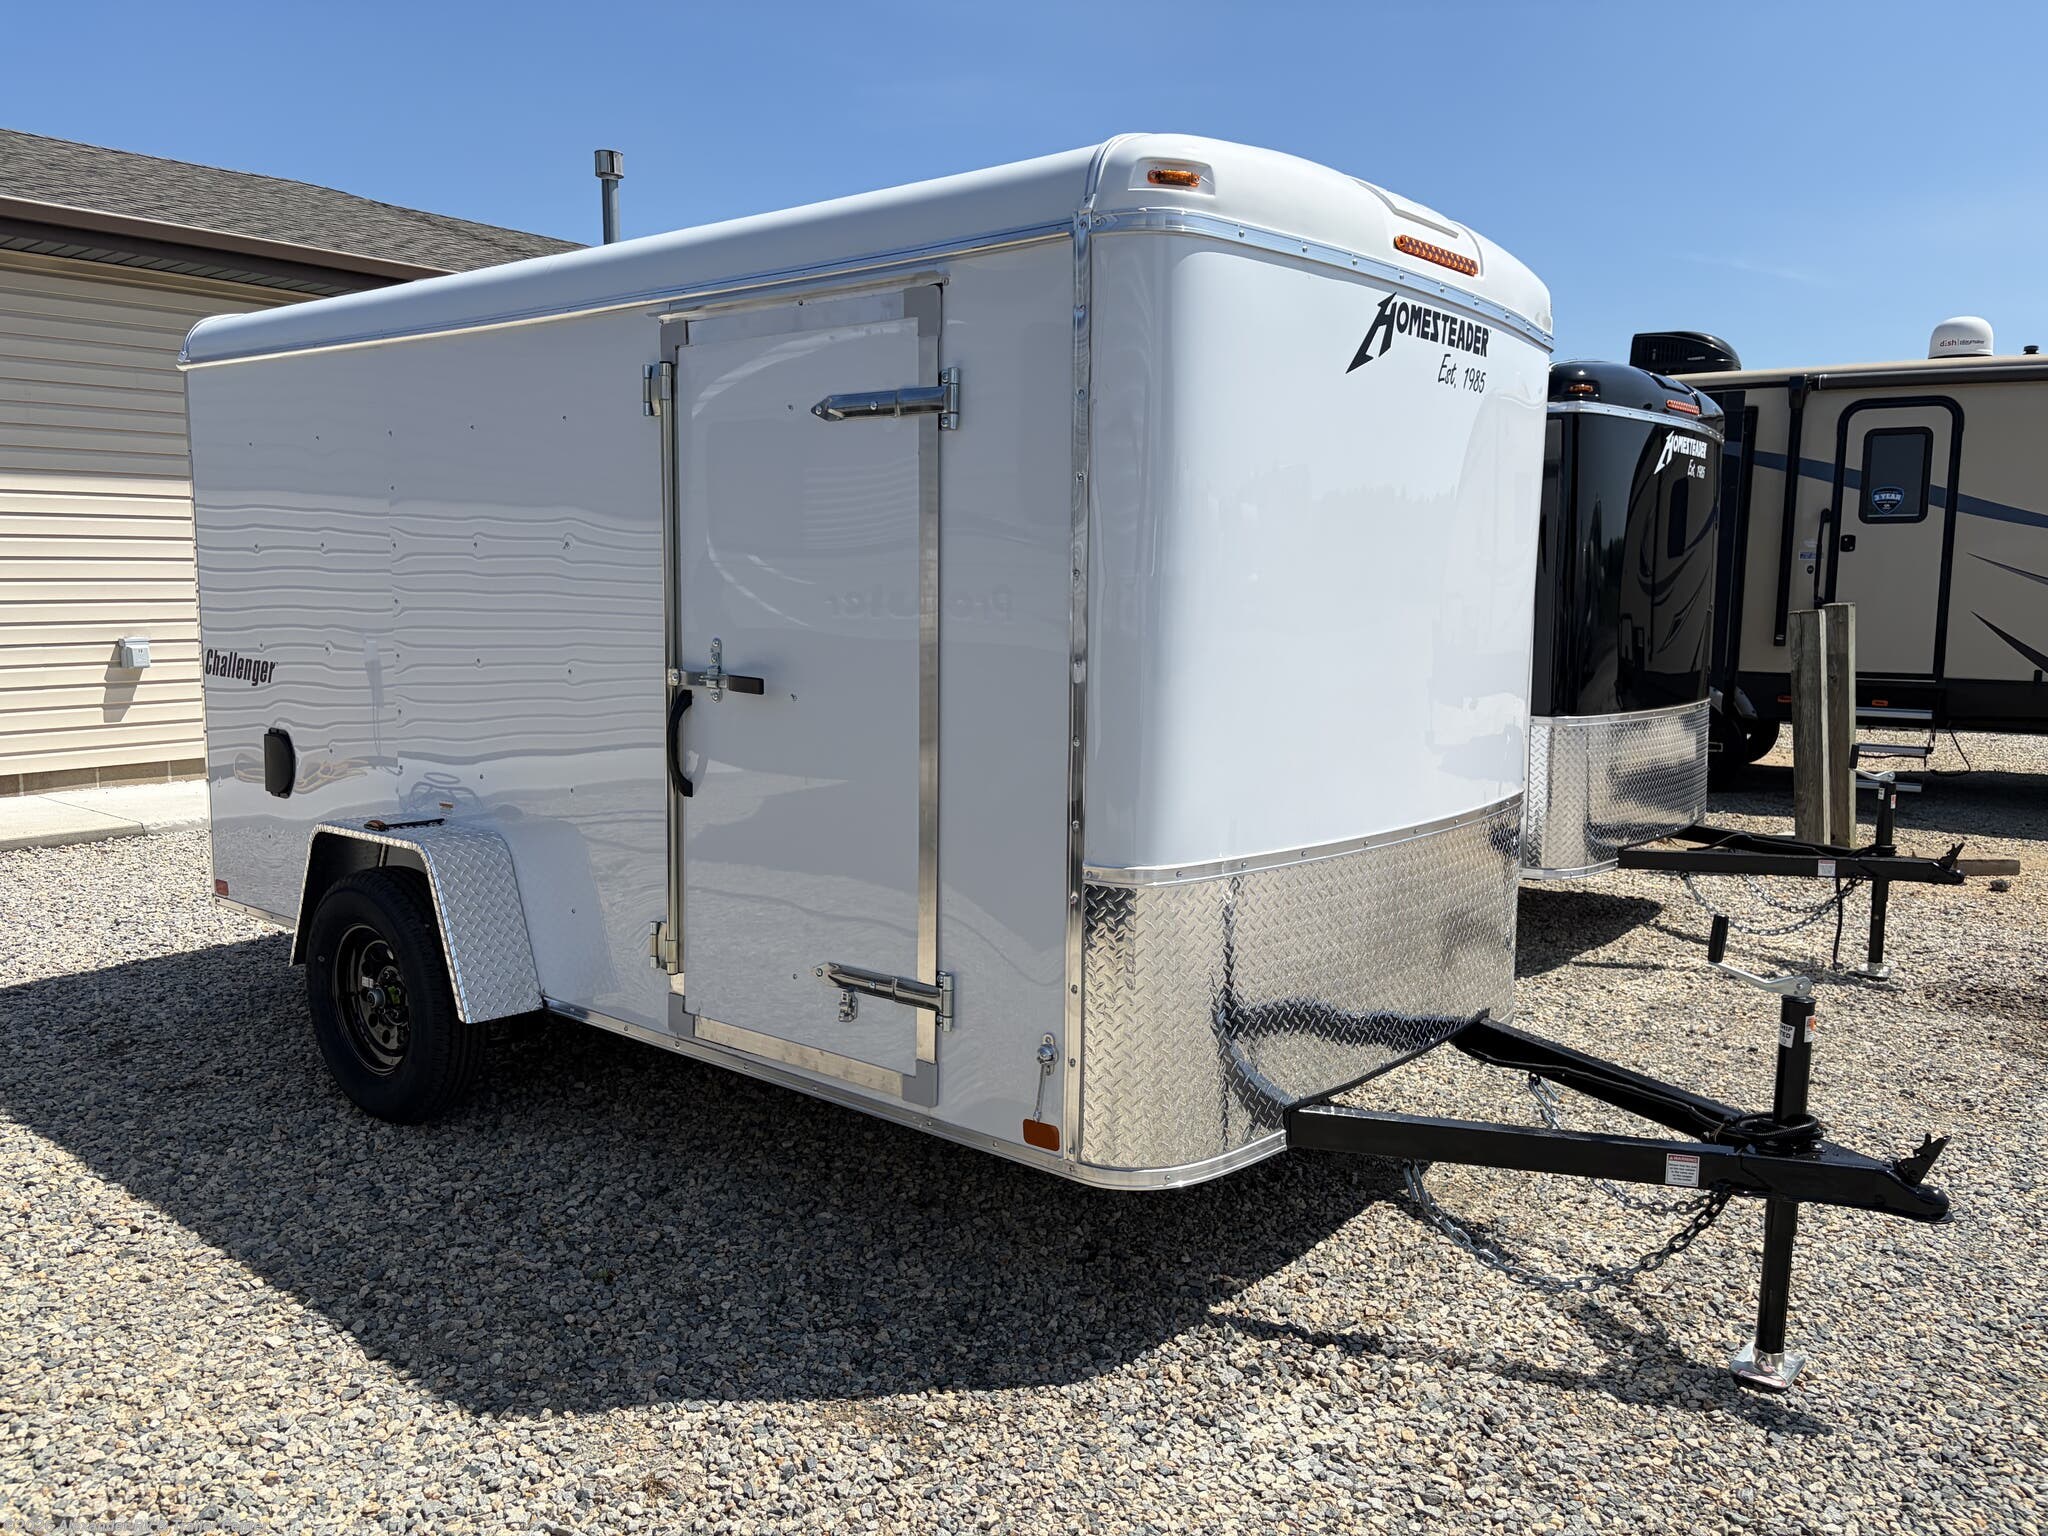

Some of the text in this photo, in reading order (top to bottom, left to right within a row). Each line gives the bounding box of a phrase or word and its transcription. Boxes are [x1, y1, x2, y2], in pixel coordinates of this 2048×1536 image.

[1345, 291, 1490, 374] HOMESTEADER
[1463, 367, 1487, 394] 1985
[1653, 430, 1708, 475] HOMESTEADER
[205, 648, 276, 687] Challenger
